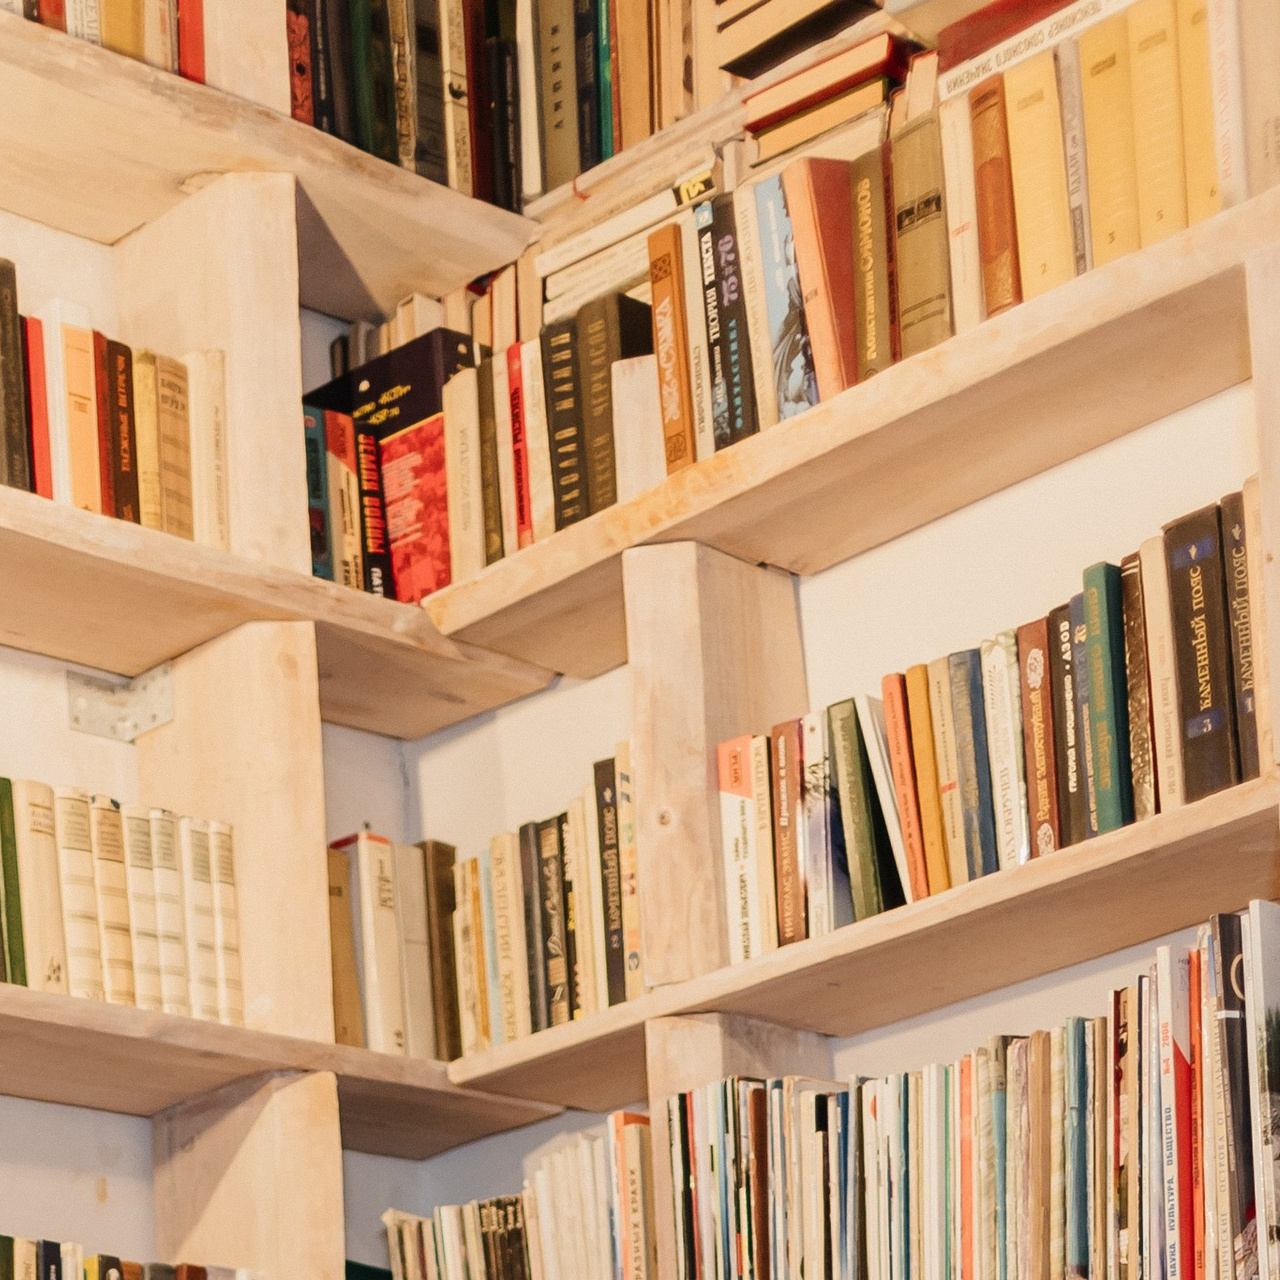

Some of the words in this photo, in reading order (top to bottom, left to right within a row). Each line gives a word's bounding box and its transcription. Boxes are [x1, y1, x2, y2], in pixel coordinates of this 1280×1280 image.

[994, 29, 1046, 66] СОЮЗНОГО
[1048, 2, 1103, 37] ПЕНСИОНЕР
[946, 56, 993, 93] ЗНАЧЕНИЯ
[857, 178, 875, 270] СИМОНОВ
[700, 231, 715, 286] ТЕКСТА
[706, 287, 720, 343] ТЕОРИЯ
[586, 318, 609, 416] ЧЕРКАСОВ
[693, 345, 706, 434] СТЕНОГРАФИЯ
[729, 318, 743, 429] ФАНТАСТИКА
[511, 387, 522, 445] ЧЕКИСТЫ
[358, 434, 383, 492] ЗЕМЛЯ
[363, 496, 385, 555] ВОЙНЫ
[1188, 565, 1203, 608] ПОЯС
[1232, 546, 1246, 592] ПОЯС
[1059, 620, 1072, 661] АЗОВ
[1187, 614, 1212, 711] КАМЕННЫЙ
[1231, 595, 1253, 691] КАМЕННЫЙ
[1064, 675, 1075, 746] МИРОШНИЧЕНКО
[1067, 748, 1077, 793] ГРИГОРИЙ
[603, 806, 615, 844] ПОЯС
[781, 832, 793, 872] ЭВАНС
[494, 856, 511, 959] ВАЛЕНТИН
[602, 849, 620, 931] КАМЕННЫЙ
[782, 876, 795, 937] НИКОЛАС
[1160, 1021, 1170, 1048] 2006
[1217, 1133, 1227, 1194] ОСТРОВА
